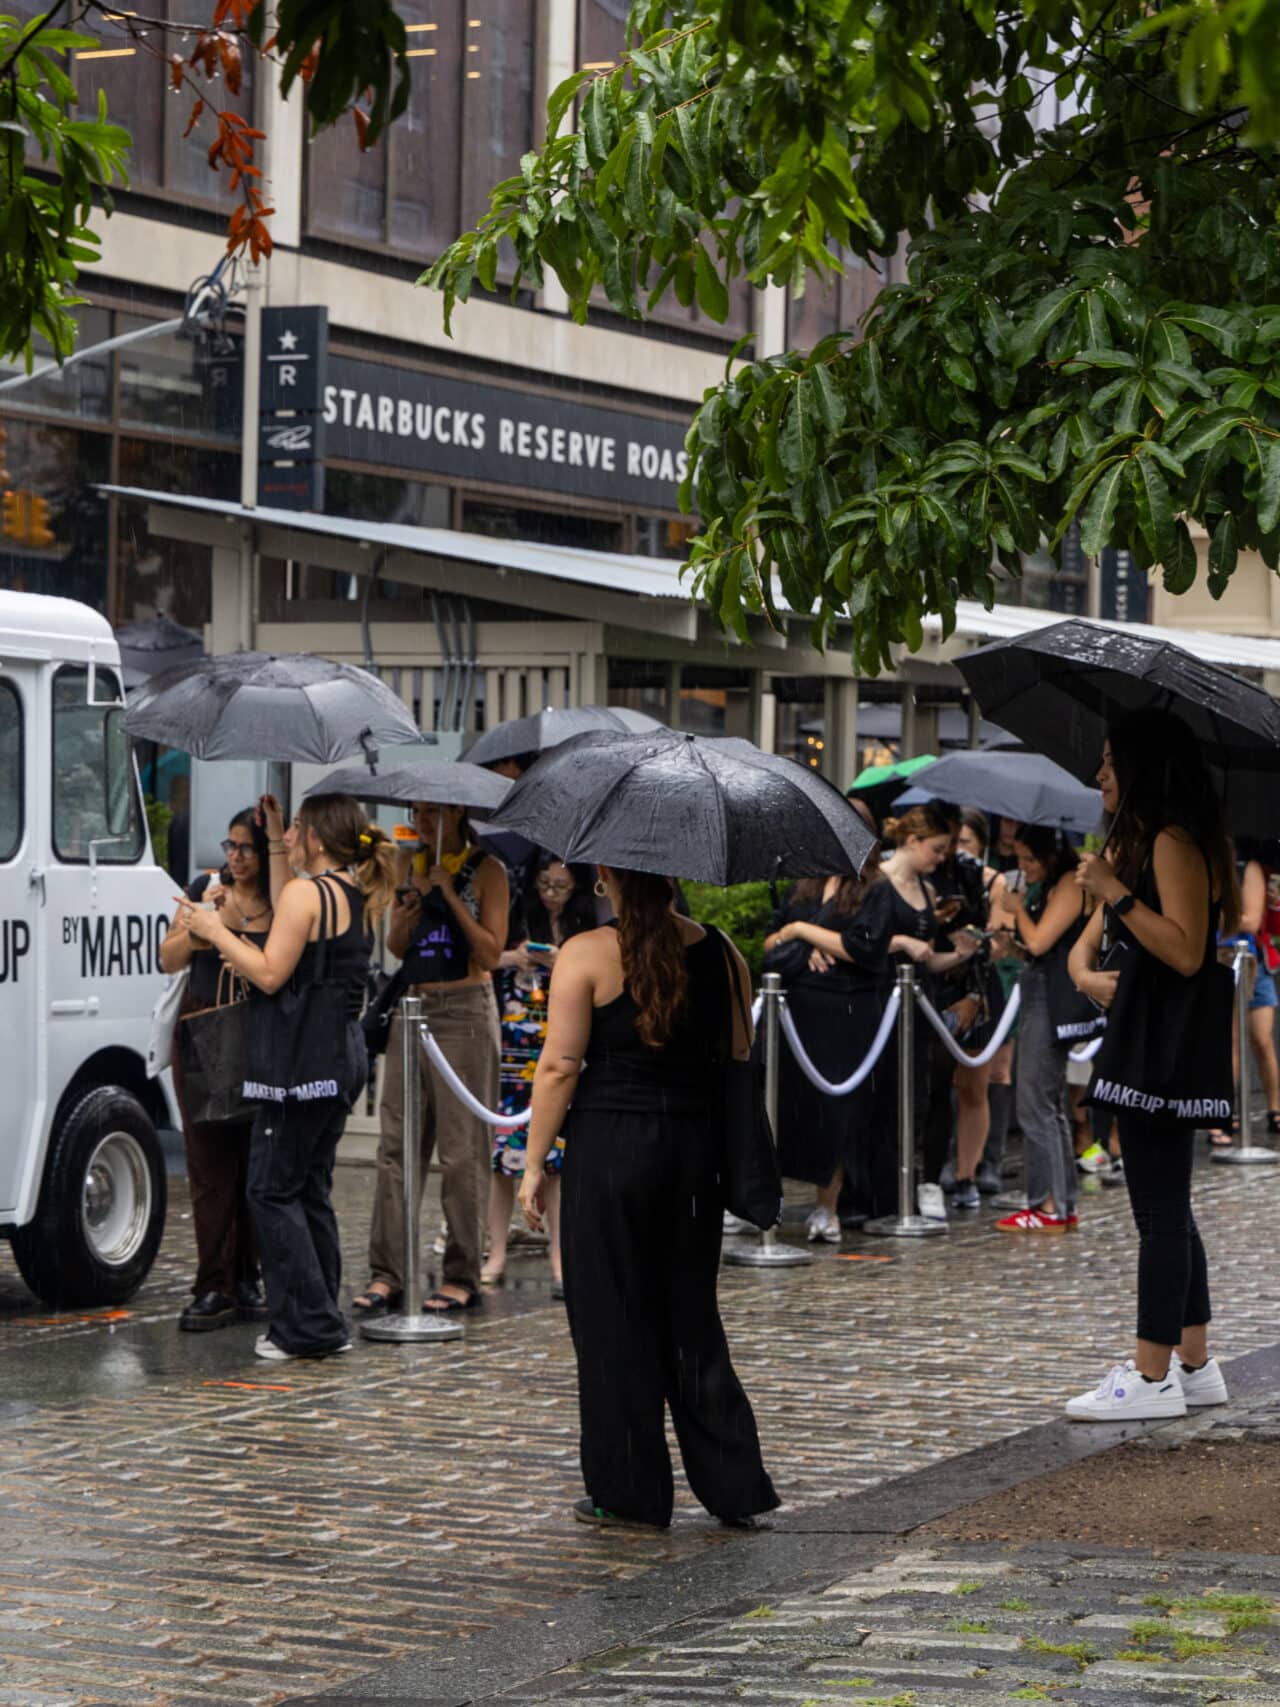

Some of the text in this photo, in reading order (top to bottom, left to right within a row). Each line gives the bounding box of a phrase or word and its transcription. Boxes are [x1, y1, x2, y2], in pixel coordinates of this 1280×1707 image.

[279, 365, 297, 386] R
[322, 385, 485, 449] STARBUCKS
[499, 418, 616, 471] RESERVE
[62, 916, 80, 944] BY
[80, 913, 170, 978] MARIO
[242, 1080, 287, 1103] MAKEUP
[296, 1079, 338, 1102] MARIO
[1093, 1078, 1165, 1113] MAKEUP
[1176, 1099, 1231, 1118] MARIO
